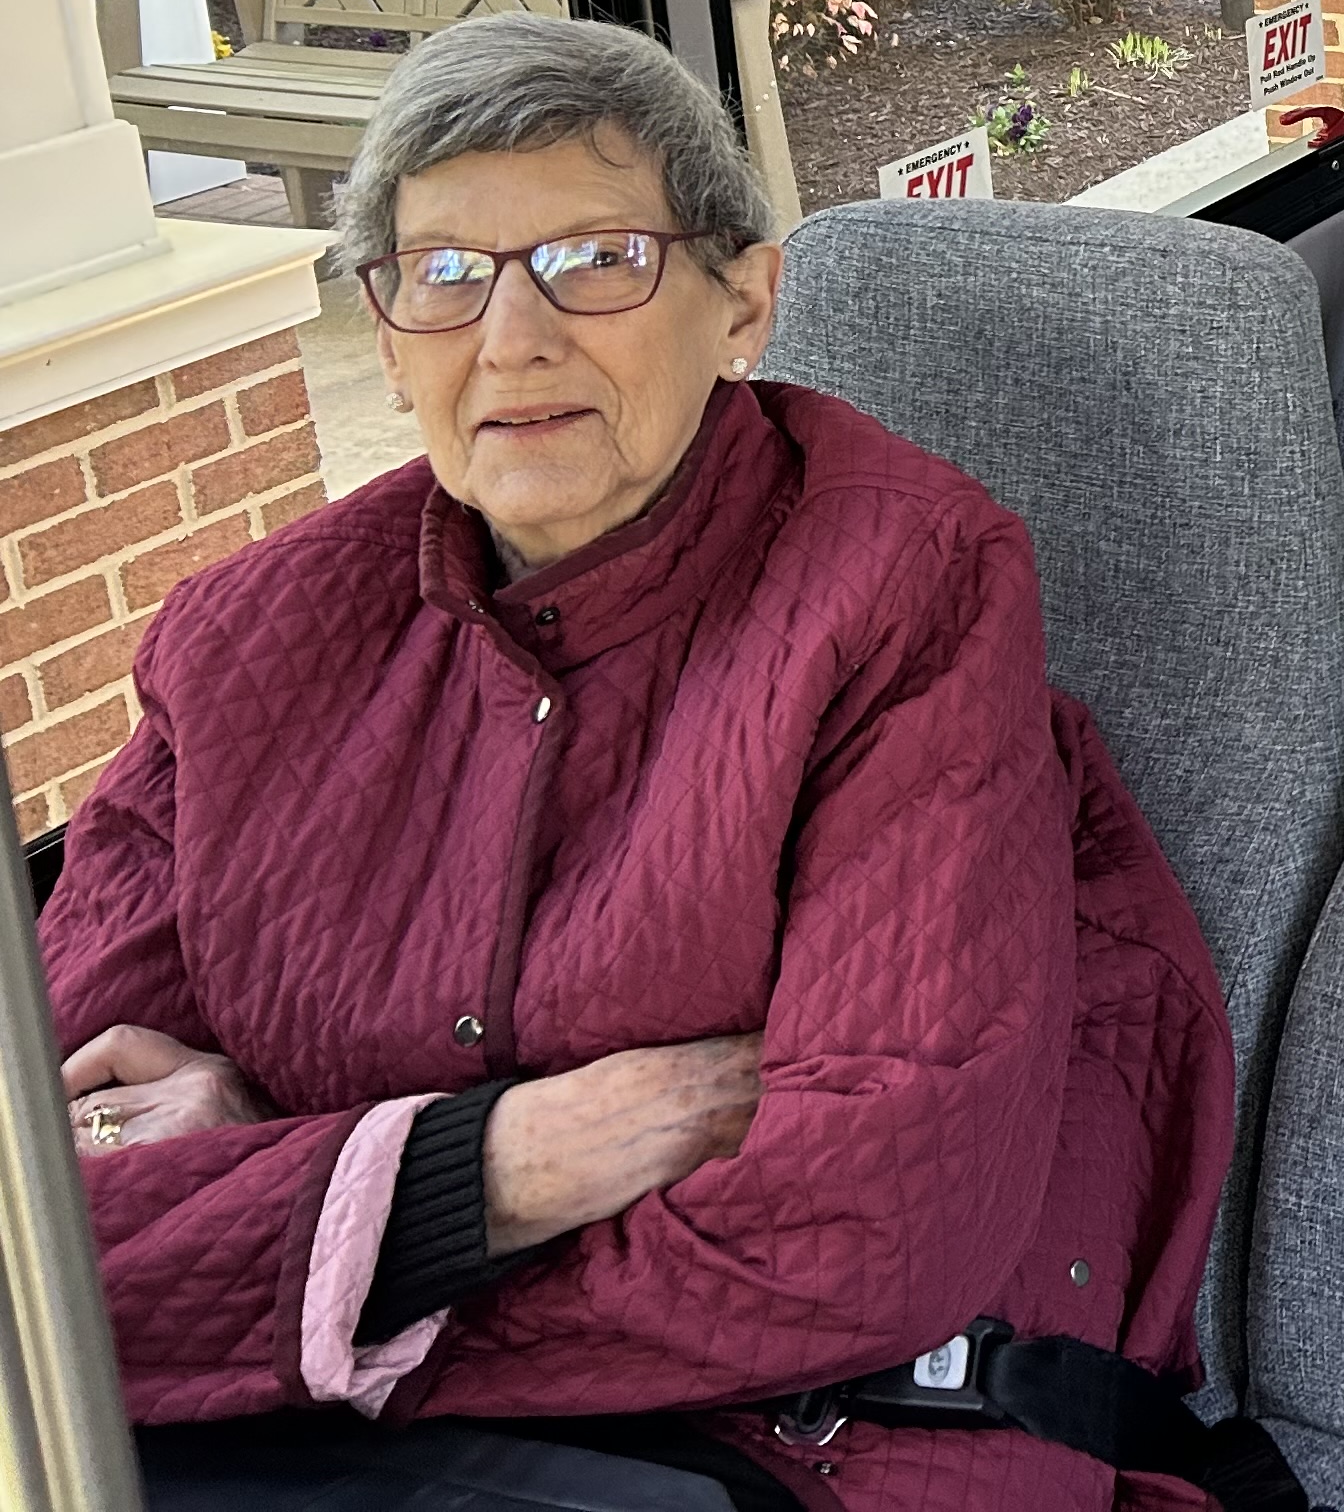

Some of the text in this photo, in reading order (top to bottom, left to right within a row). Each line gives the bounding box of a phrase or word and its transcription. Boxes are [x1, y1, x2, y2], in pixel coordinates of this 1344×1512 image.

[1264, 2, 1304, 28] EMERGENCY
[1263, 13, 1312, 71] EXIT
[1260, 72, 1272, 85] Pull
[1280, 73, 1303, 89] Window
[905, 141, 963, 175] EMERGENCY
